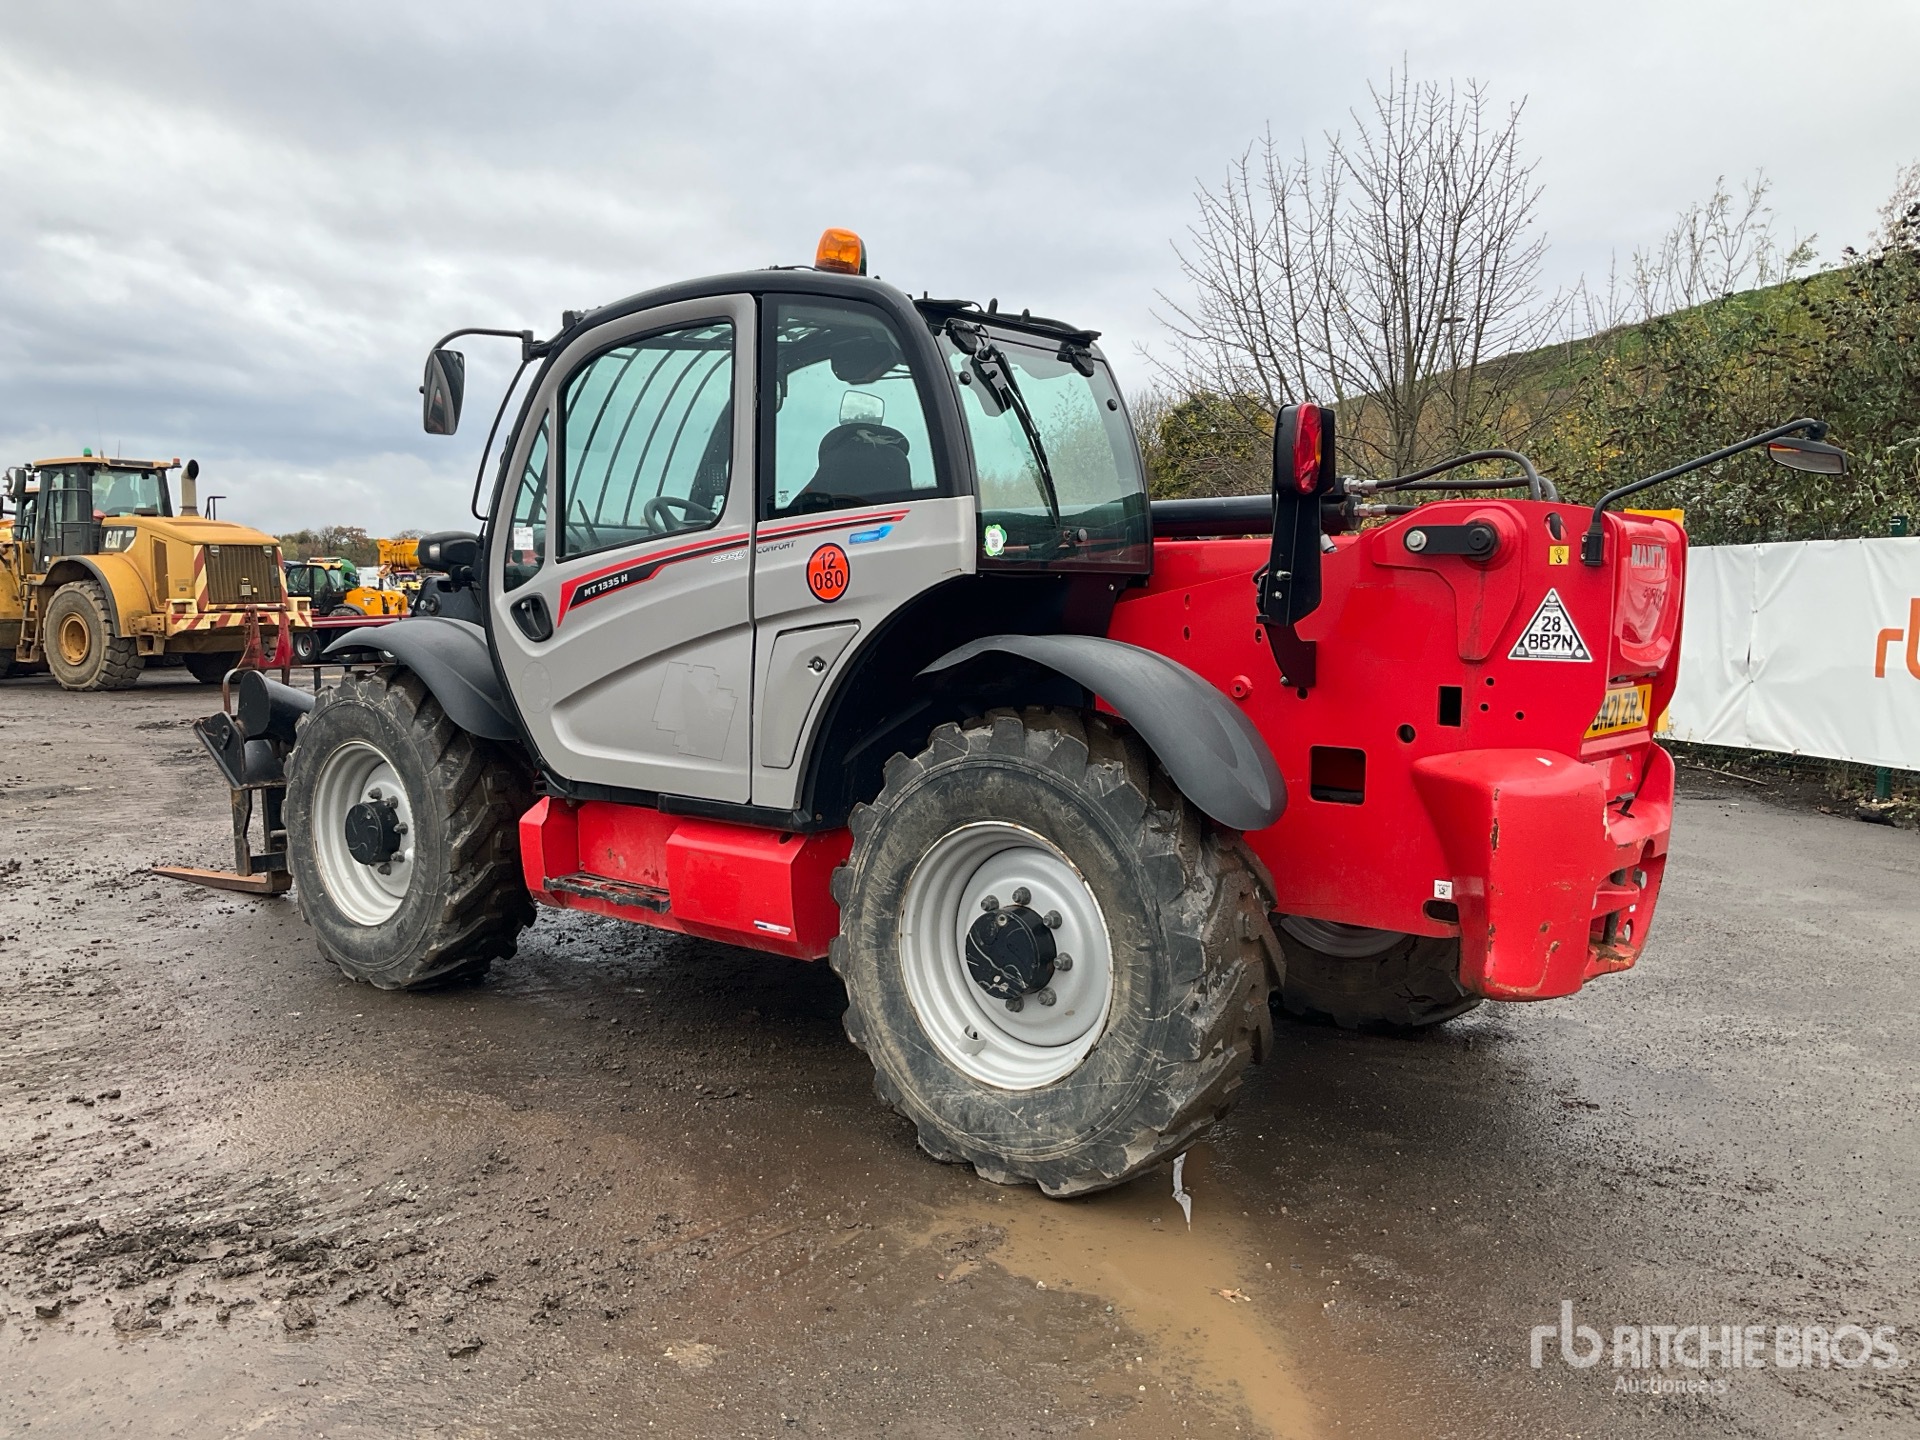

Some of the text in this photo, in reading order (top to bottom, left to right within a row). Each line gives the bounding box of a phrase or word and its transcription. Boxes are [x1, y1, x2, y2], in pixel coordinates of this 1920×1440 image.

[105, 530, 124, 549] CAT
[819, 552, 837, 570] 12
[584, 573, 628, 597] MT 1335 H
[813, 570, 845, 591] 080
[1541, 616, 1561, 632] 28
[1528, 633, 1573, 651] BB7N
